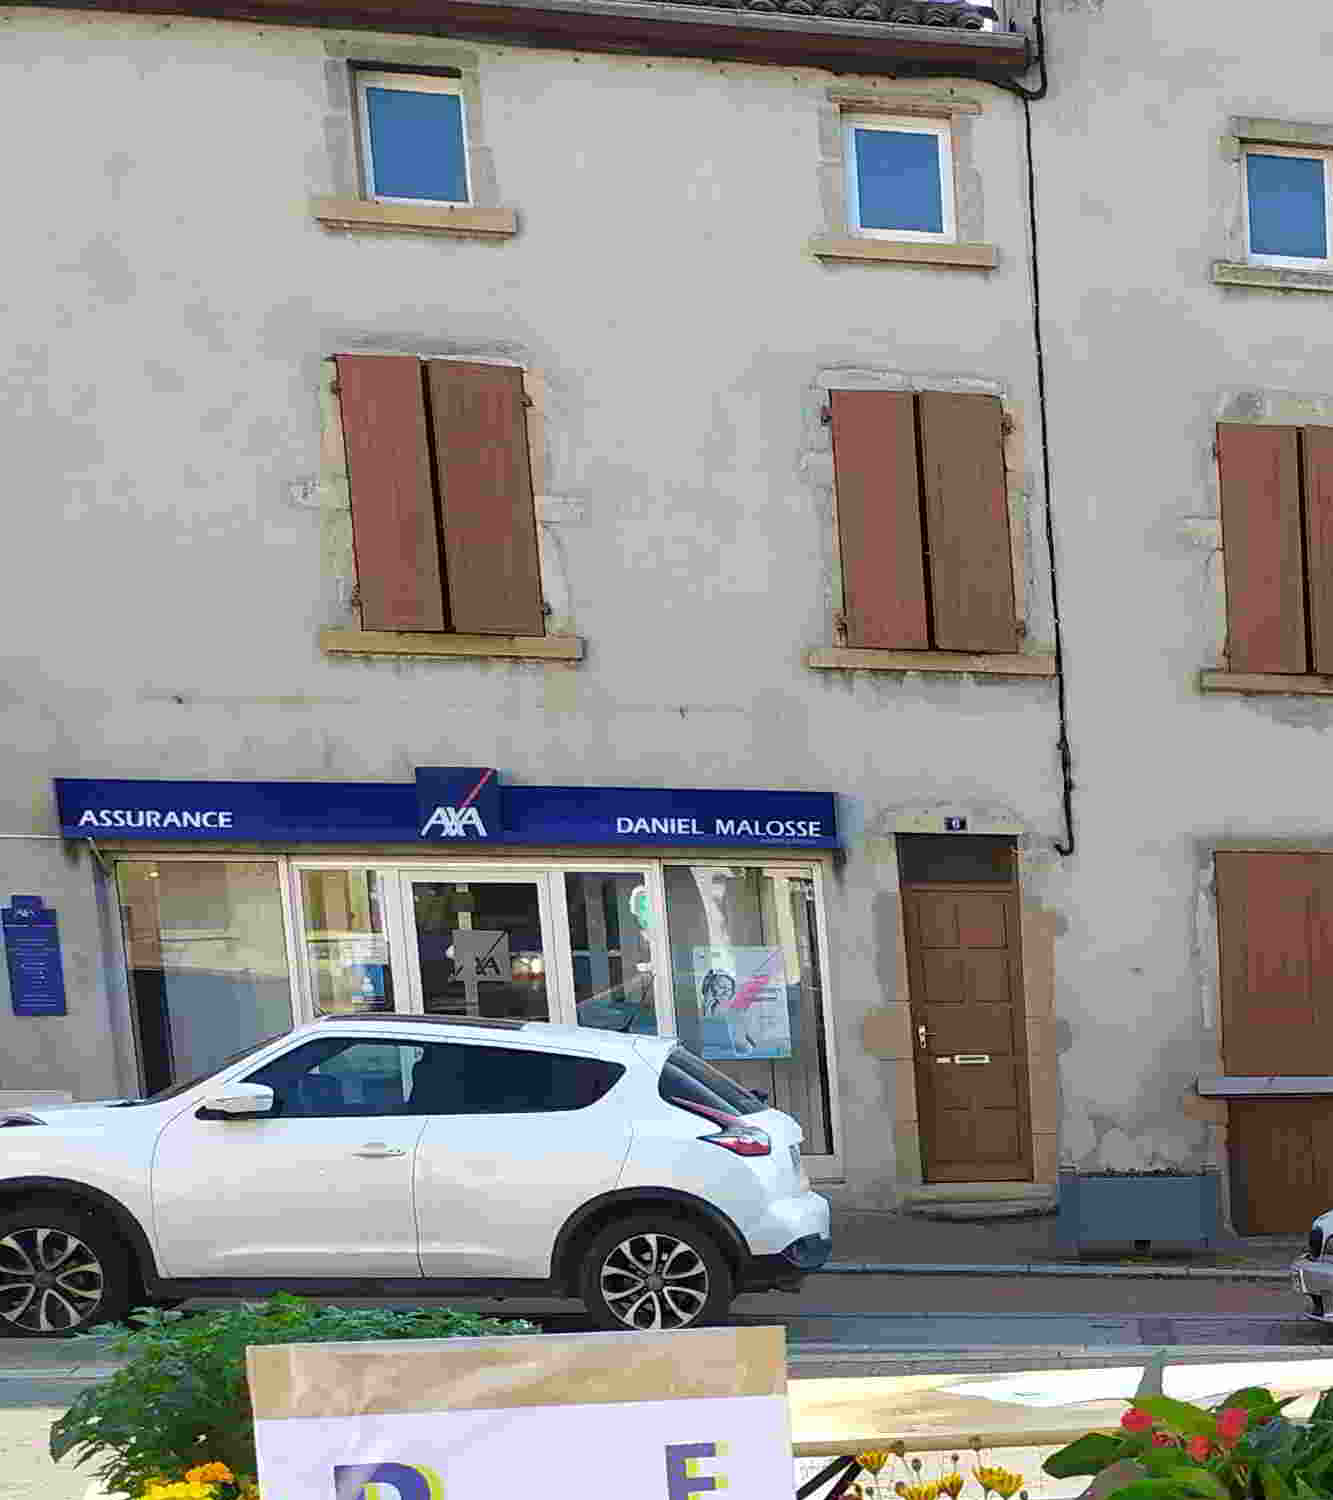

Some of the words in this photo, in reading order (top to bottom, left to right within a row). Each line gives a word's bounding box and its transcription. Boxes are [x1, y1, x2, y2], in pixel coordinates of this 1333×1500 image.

[78, 809, 233, 829] ASSURANCE
[420, 806, 488, 838] AXA
[616, 817, 704, 835] DANIEL
[715, 819, 822, 837] MALOSSE
